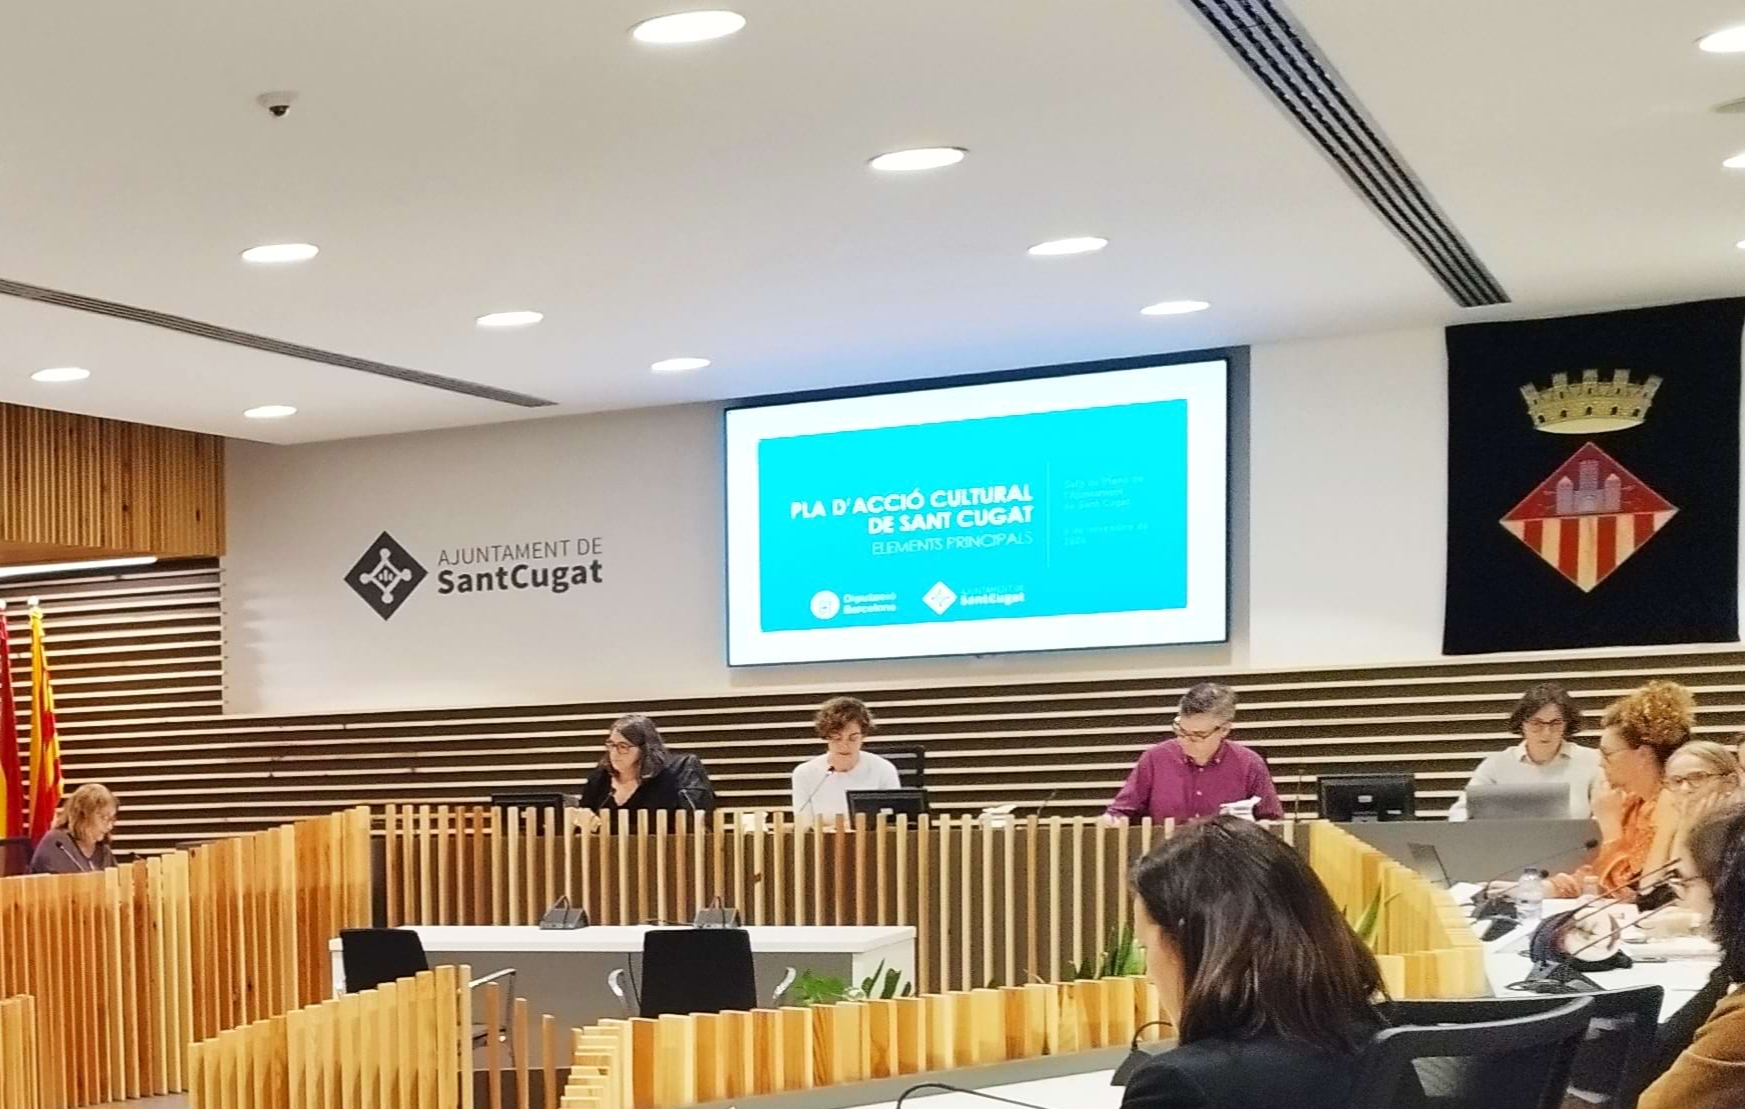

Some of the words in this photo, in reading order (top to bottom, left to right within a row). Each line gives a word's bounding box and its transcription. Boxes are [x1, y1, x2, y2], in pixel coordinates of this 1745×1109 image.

[790, 501, 827, 519] PLA
[832, 488, 925, 516] D'ACCIÓ
[930, 484, 1034, 508] CULTURAL
[868, 515, 894, 535] DE
[899, 511, 952, 532] SANT
[957, 505, 1035, 528] CUGAT
[438, 540, 571, 567] AJUNTAMENT
[576, 537, 603, 556] DE
[871, 536, 943, 555] ELEMENTS
[946, 530, 1034, 549] PRINCIPALS
[438, 559, 603, 595] SantCugat
